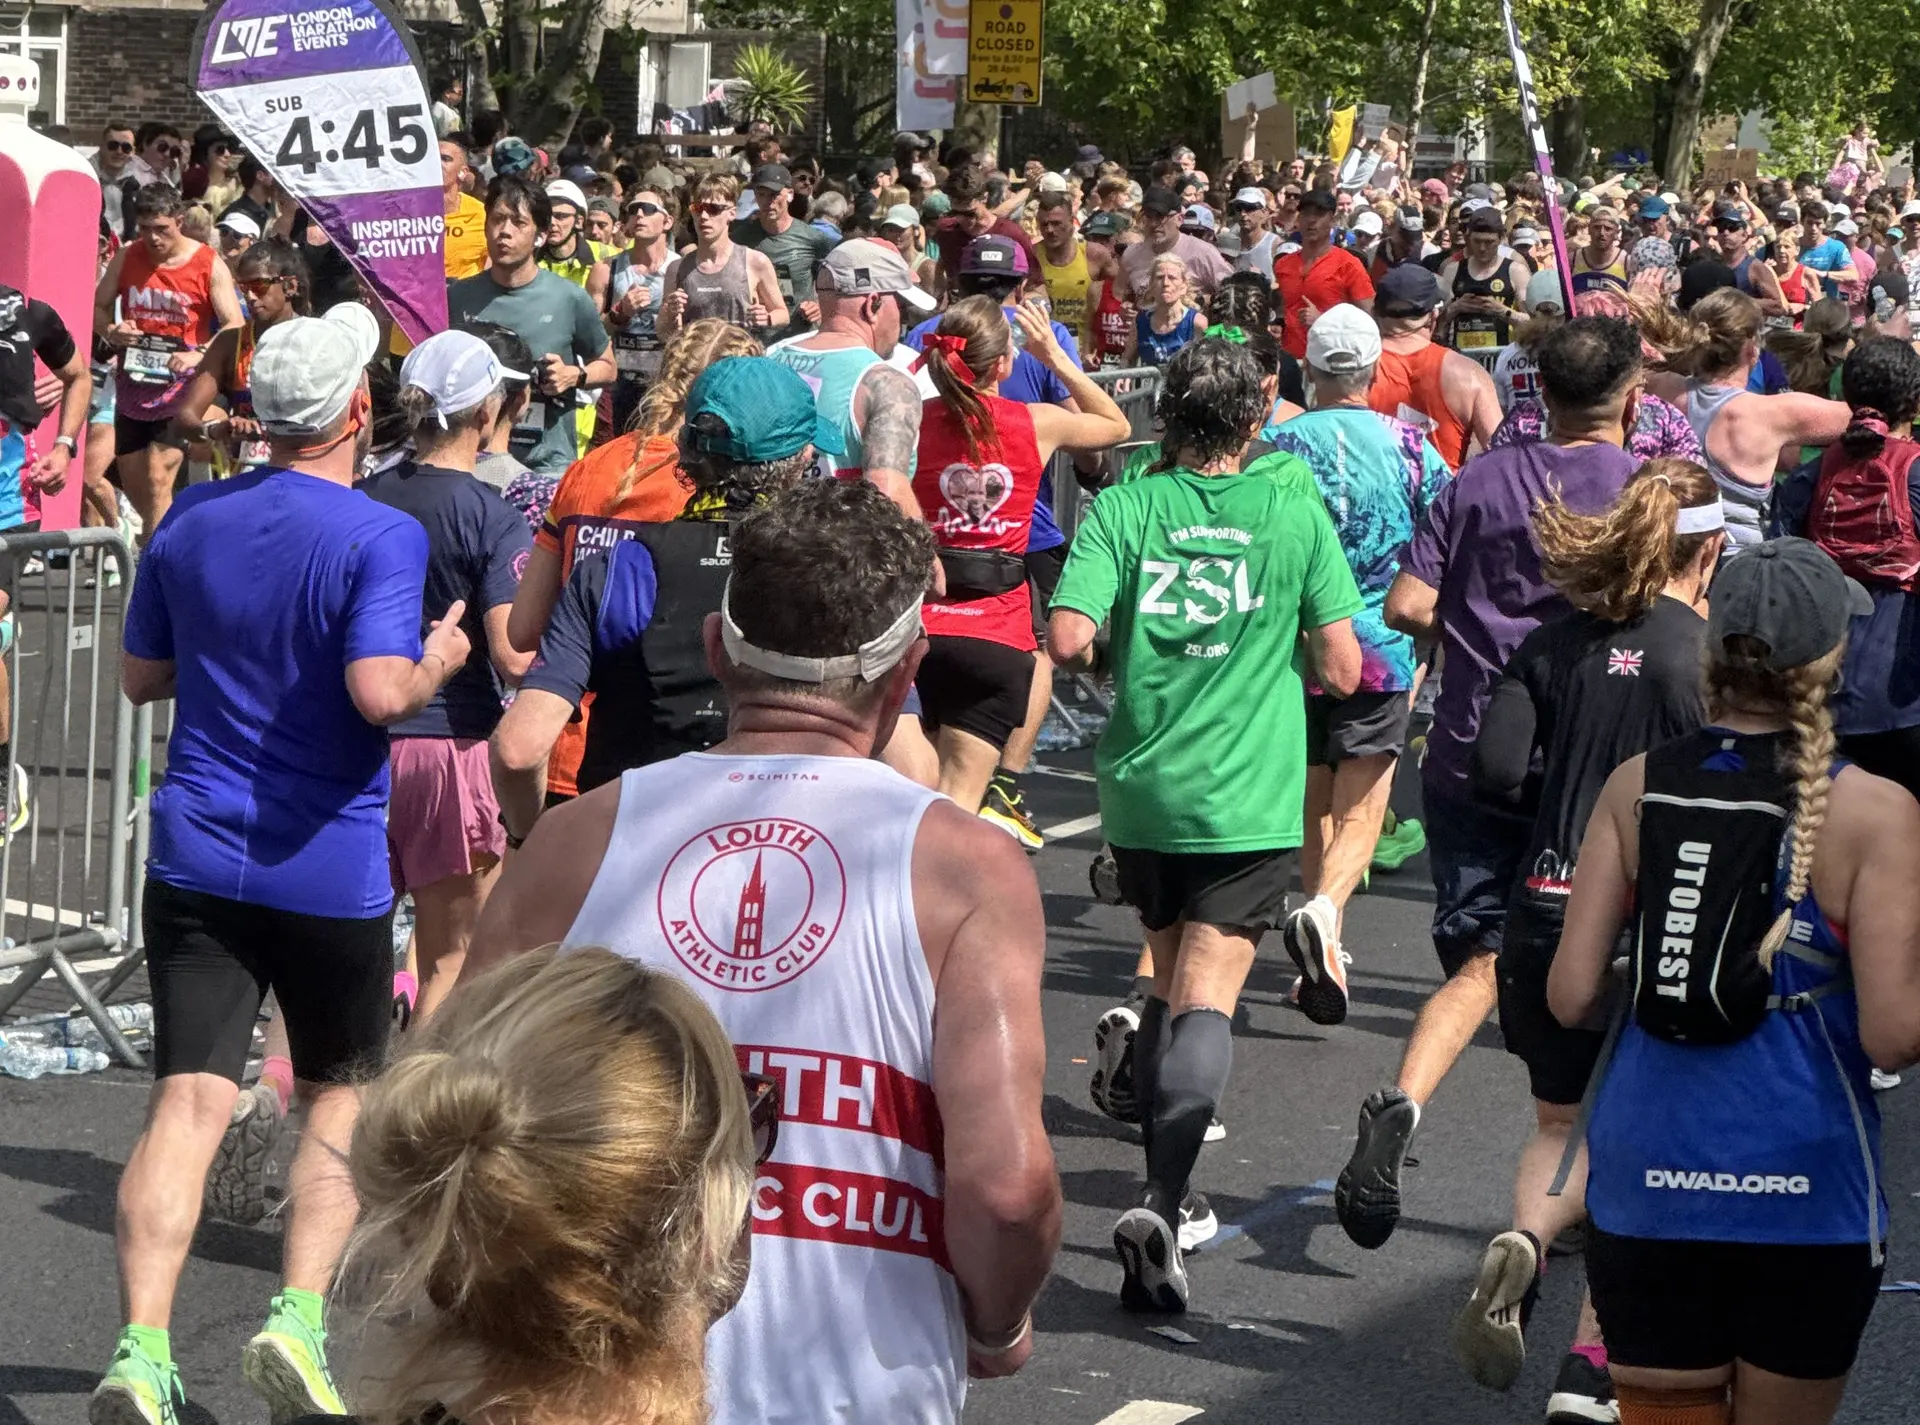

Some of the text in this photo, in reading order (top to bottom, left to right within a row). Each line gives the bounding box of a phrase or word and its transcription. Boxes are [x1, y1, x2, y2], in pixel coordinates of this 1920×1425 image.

[289, 6, 353, 26] LONDON
[292, 16, 377, 39] MARATHON
[985, 21, 1026, 34] ROAD
[294, 34, 348, 51] EVENTS
[976, 37, 1034, 51] CLOSED
[265, 95, 303, 114] SUB
[275, 103, 428, 174] 4:45
[352, 215, 444, 240] INSPIRING
[356, 236, 439, 258] ACTIVITY
[1507, 357, 1541, 371] NOR
[1169, 525, 1253, 545] I'M SUPPORTING
[1139, 556, 1265, 625] ZSL
[1184, 642, 1230, 658] ZSL.ORG
[747, 773, 819, 782] SCIMITAR
[707, 823, 816, 853] LOUTH
[1656, 841, 1712, 1003] UTOBEST
[670, 919, 826, 983] ATHLETIC CLUB
[1645, 1169, 1810, 1195] DWAD.ORG
